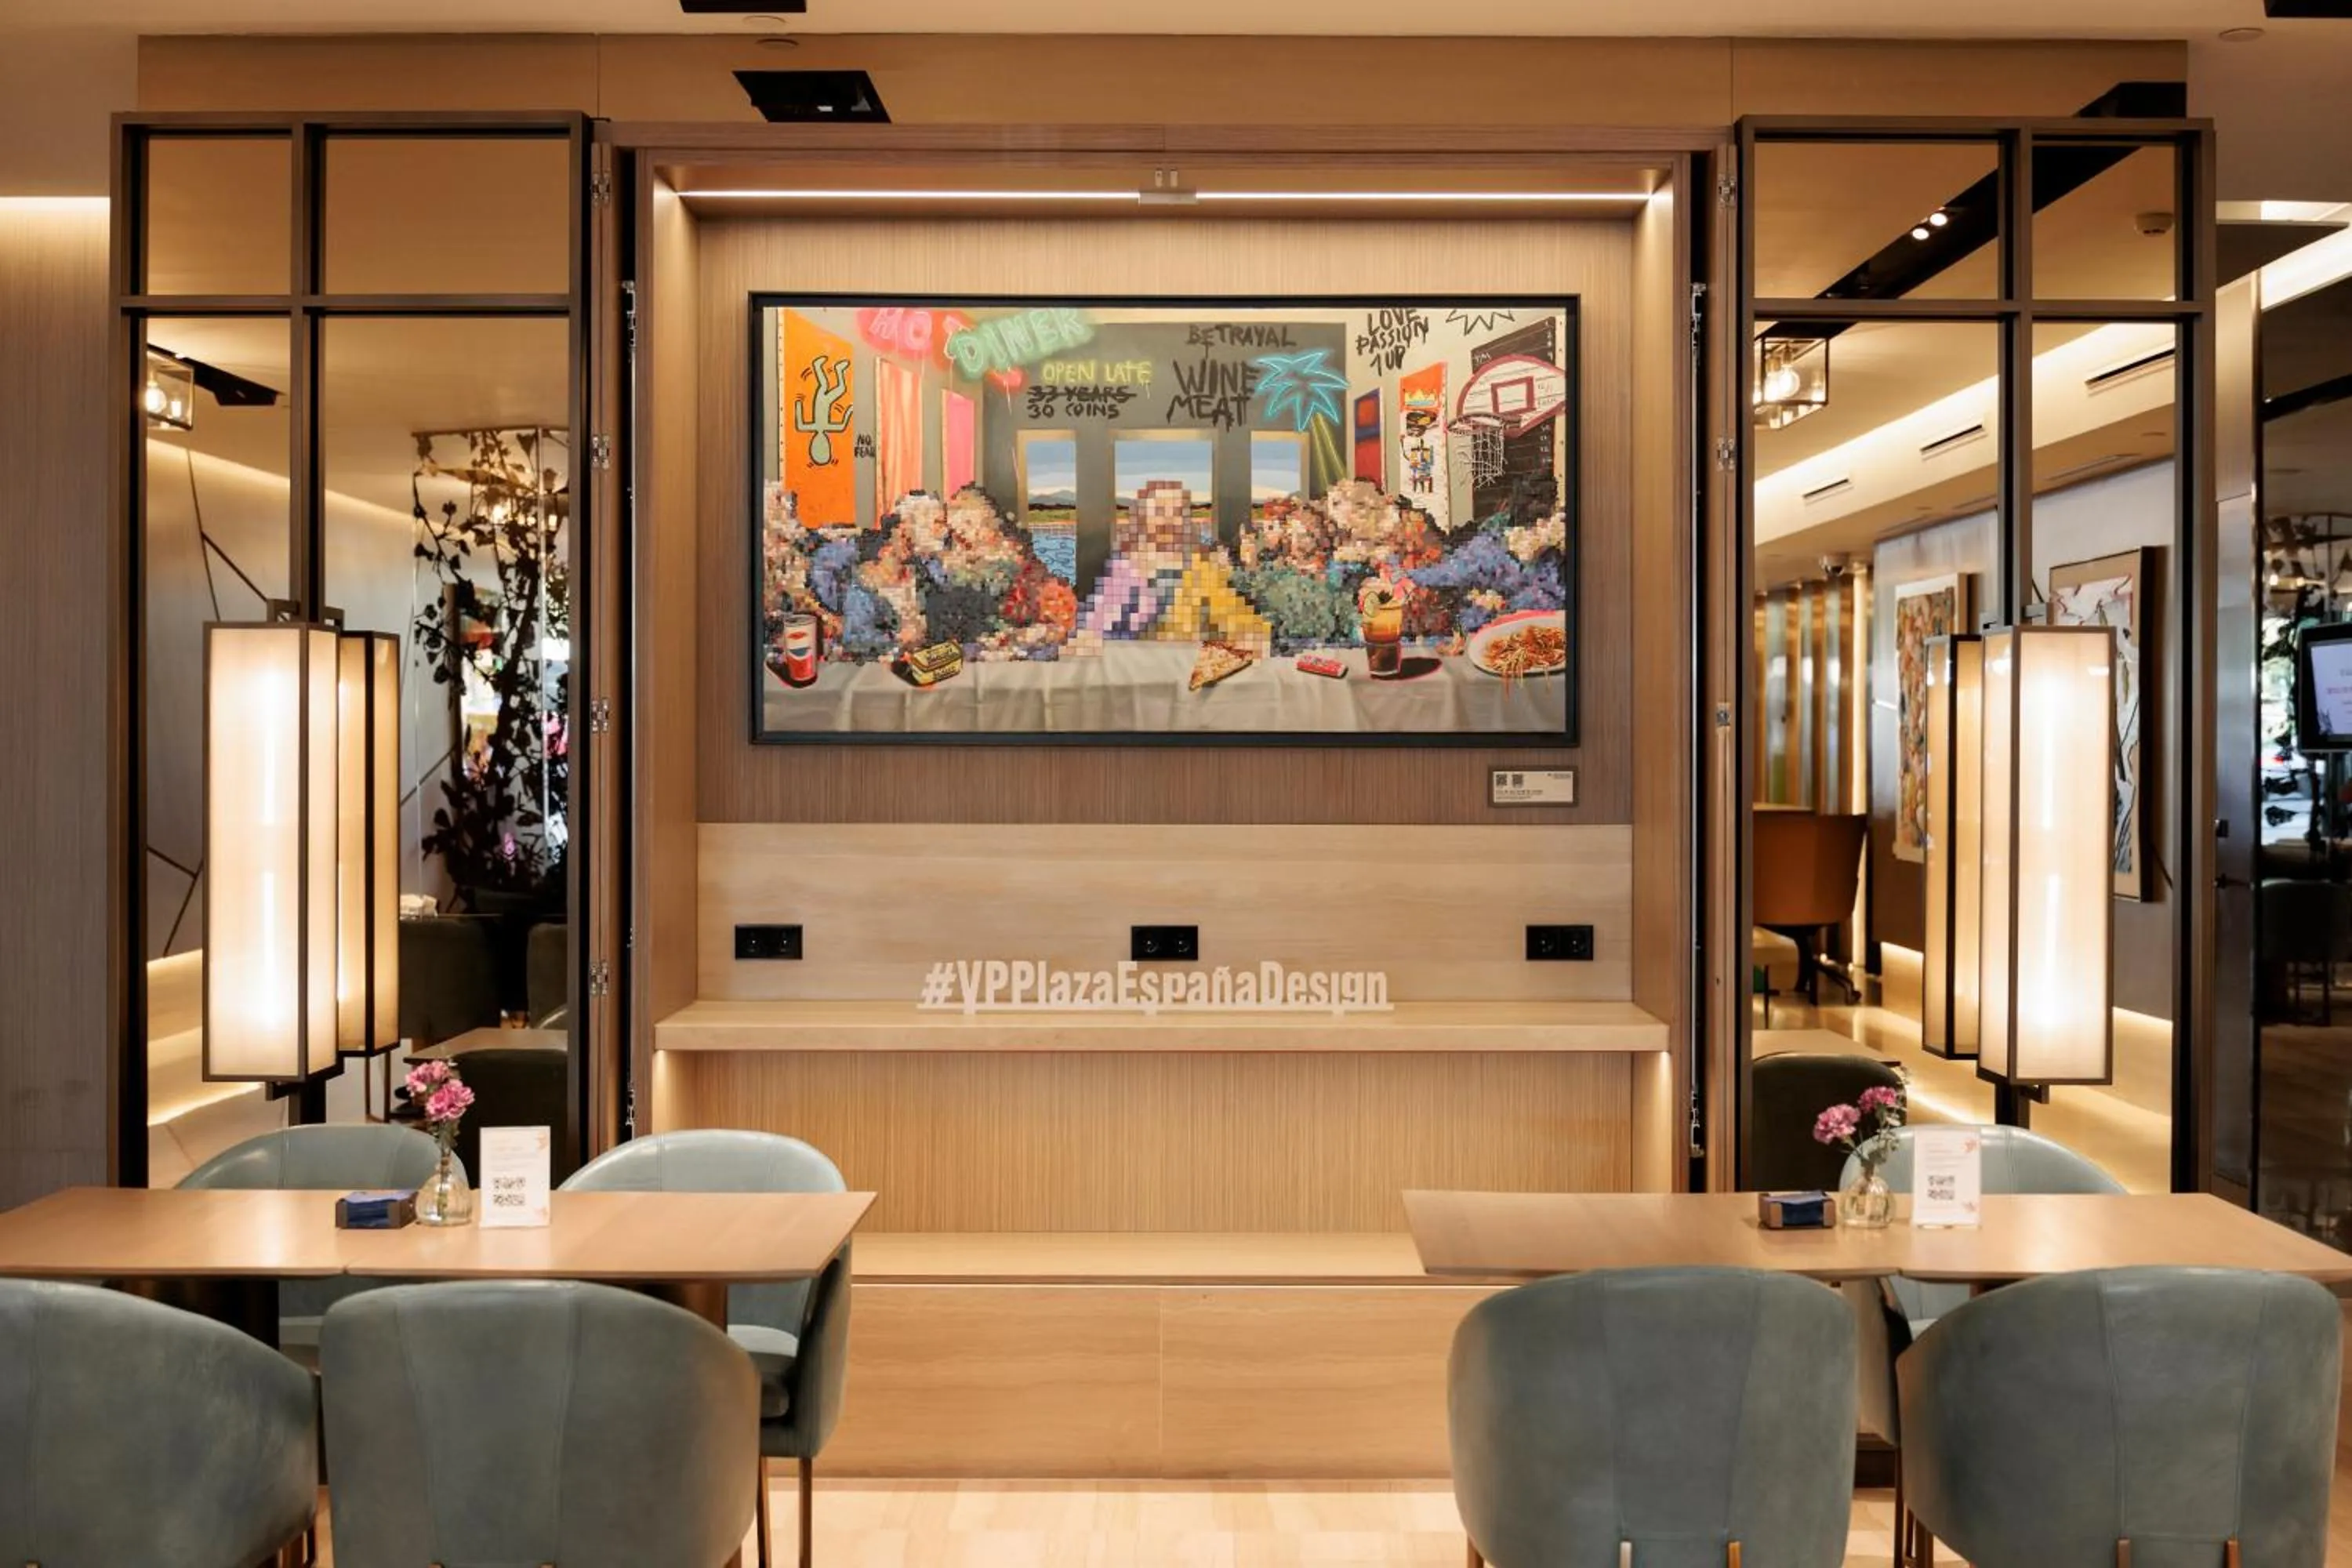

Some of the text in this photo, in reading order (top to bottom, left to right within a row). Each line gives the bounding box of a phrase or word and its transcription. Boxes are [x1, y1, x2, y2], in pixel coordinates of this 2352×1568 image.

[1355, 317, 1429, 355] PASSION
[1367, 308, 1421, 336] LOVE
[956, 307, 1080, 373] DINER
[1185, 324, 1298, 349] BETRAYAL
[1042, 360, 1152, 386] OPEN LATE
[1173, 359, 1260, 396] WINE
[1063, 385, 1133, 404] YEARS
[1026, 402, 1120, 419] 30 COINS
[1167, 394, 1250, 433] MEAT
